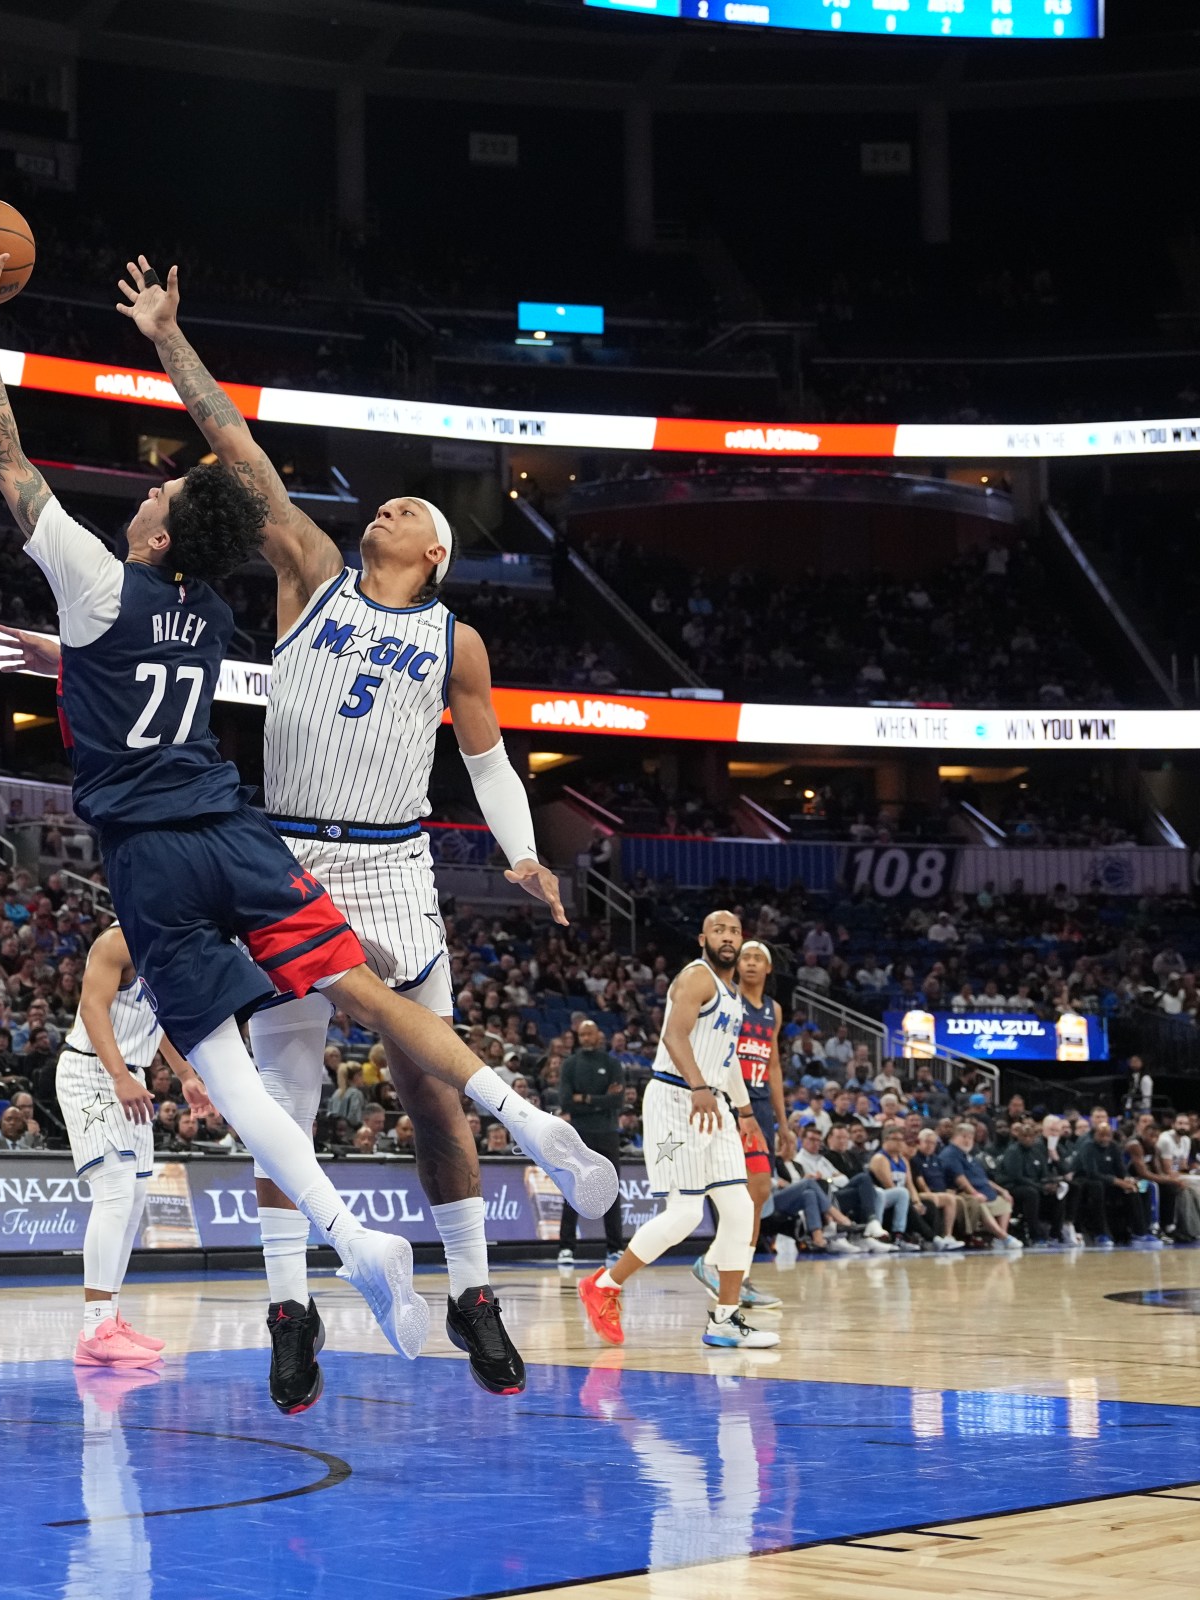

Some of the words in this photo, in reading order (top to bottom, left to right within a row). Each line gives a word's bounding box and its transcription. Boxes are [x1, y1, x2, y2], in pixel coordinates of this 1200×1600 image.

[492, 416, 514, 434] YOU
[1141, 428, 1166, 444] YOU
[152, 611, 207, 647] RILEY
[126, 662, 205, 749] 27
[338, 673, 384, 718] 5
[874, 717, 918, 739] WHEN
[924, 717, 948, 740] THE
[1005, 718, 1035, 740] WIN
[1041, 719, 1073, 740] YOU
[1078, 719, 1116, 740] WIN!
[853, 848, 947, 898] 108
[946, 1019, 1045, 1036] LUNAZUL
[723, 1042, 735, 1068] 2
[751, 1063, 767, 1088] 12
[2, 1207, 78, 1244] Tequila
